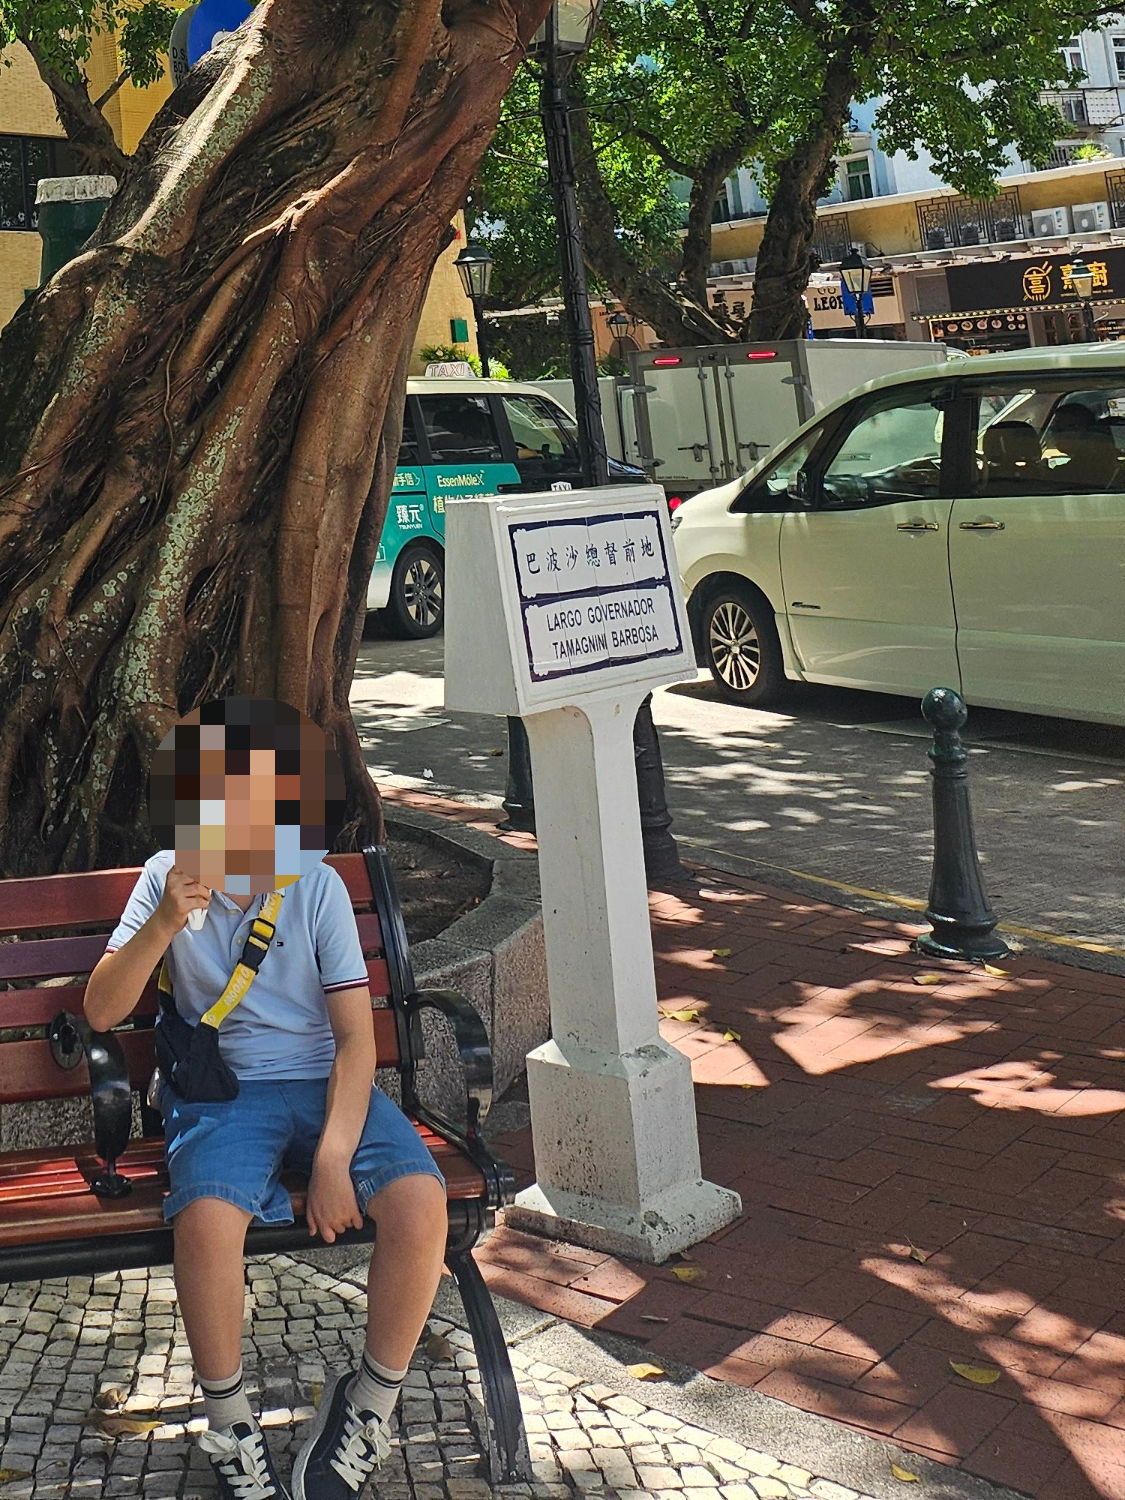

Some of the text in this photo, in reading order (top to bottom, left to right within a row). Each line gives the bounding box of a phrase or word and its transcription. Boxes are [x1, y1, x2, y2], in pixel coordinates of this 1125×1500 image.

[429, 363, 465, 378] TAXI
[525, 535, 655, 575] 巴波沙總督前地
[546, 597, 655, 632] LARGO GOVERNADOR
[552, 625, 659, 660] TAMAGNINI BARBOSA
